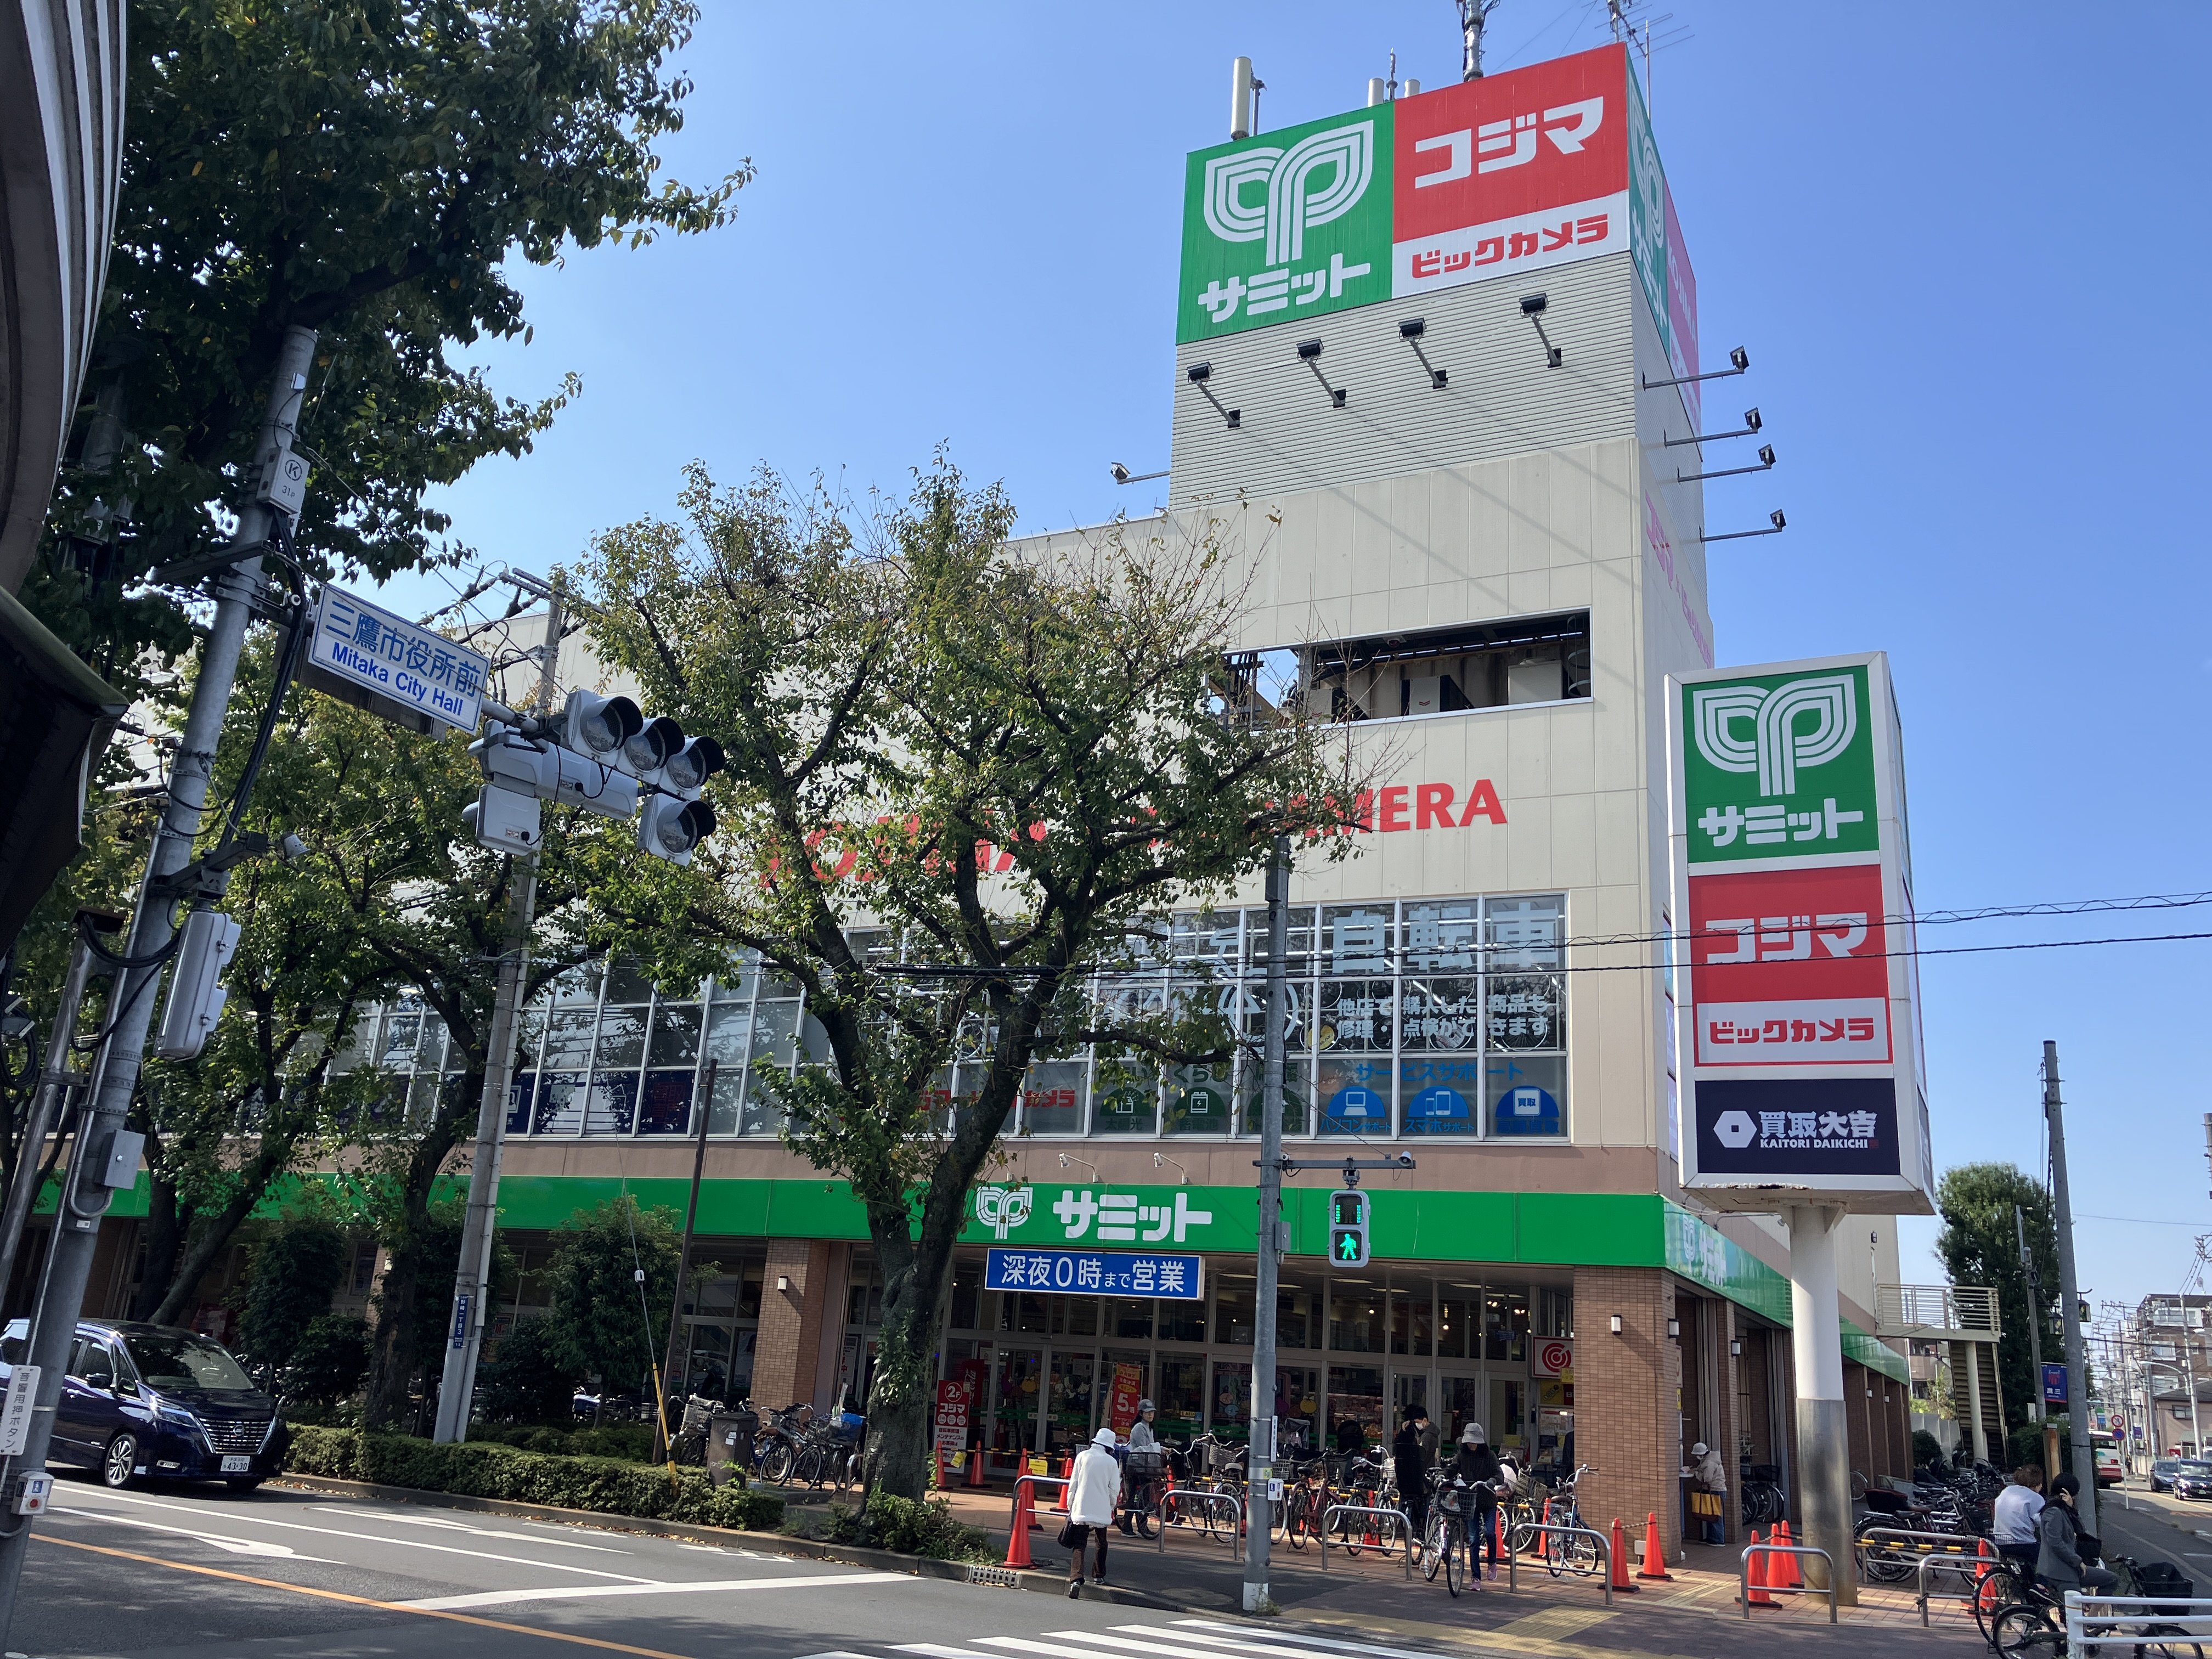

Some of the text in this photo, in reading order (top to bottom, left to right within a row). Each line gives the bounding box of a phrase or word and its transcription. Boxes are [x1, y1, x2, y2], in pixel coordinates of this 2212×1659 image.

[1414, 96, 1604, 188] コジマ
[1411, 213, 1609, 279] ビックカメラ
[1631, 204, 1667, 327] サミット
[1198, 252, 1370, 323] サミット
[325, 601, 481, 698] 三鷹市役所前
[331, 642, 463, 716] Mitaka City Hall
[1698, 798, 1863, 847] サミット
[1332, 902, 1559, 974] 自転車
[1706, 912, 1867, 962] コジマ
[1709, 1017, 1875, 1044] ビックカメラ
[1356, 1062, 1522, 1081] サービスサポート
[1319, 1119, 1391, 1132] パソコンサポート
[1404, 1119, 1474, 1132] スマホサポート
[1518, 1098, 1536, 1107] 買取
[1758, 1110, 1877, 1138] 買取大吉
[1760, 1139, 1809, 1148] KAITORI
[1813, 1139, 1868, 1148] DAIKICHI
[1053, 1190, 1212, 1242] サミット
[1002, 1255, 1185, 1293] 深夜0時まで営業
[1699, 1228, 1726, 1286] サミット
[5, 1373, 30, 1448] 音響用押ボタン
[940, 1403, 965, 1414] コジマ
[947, 1385, 960, 1398] 2F
